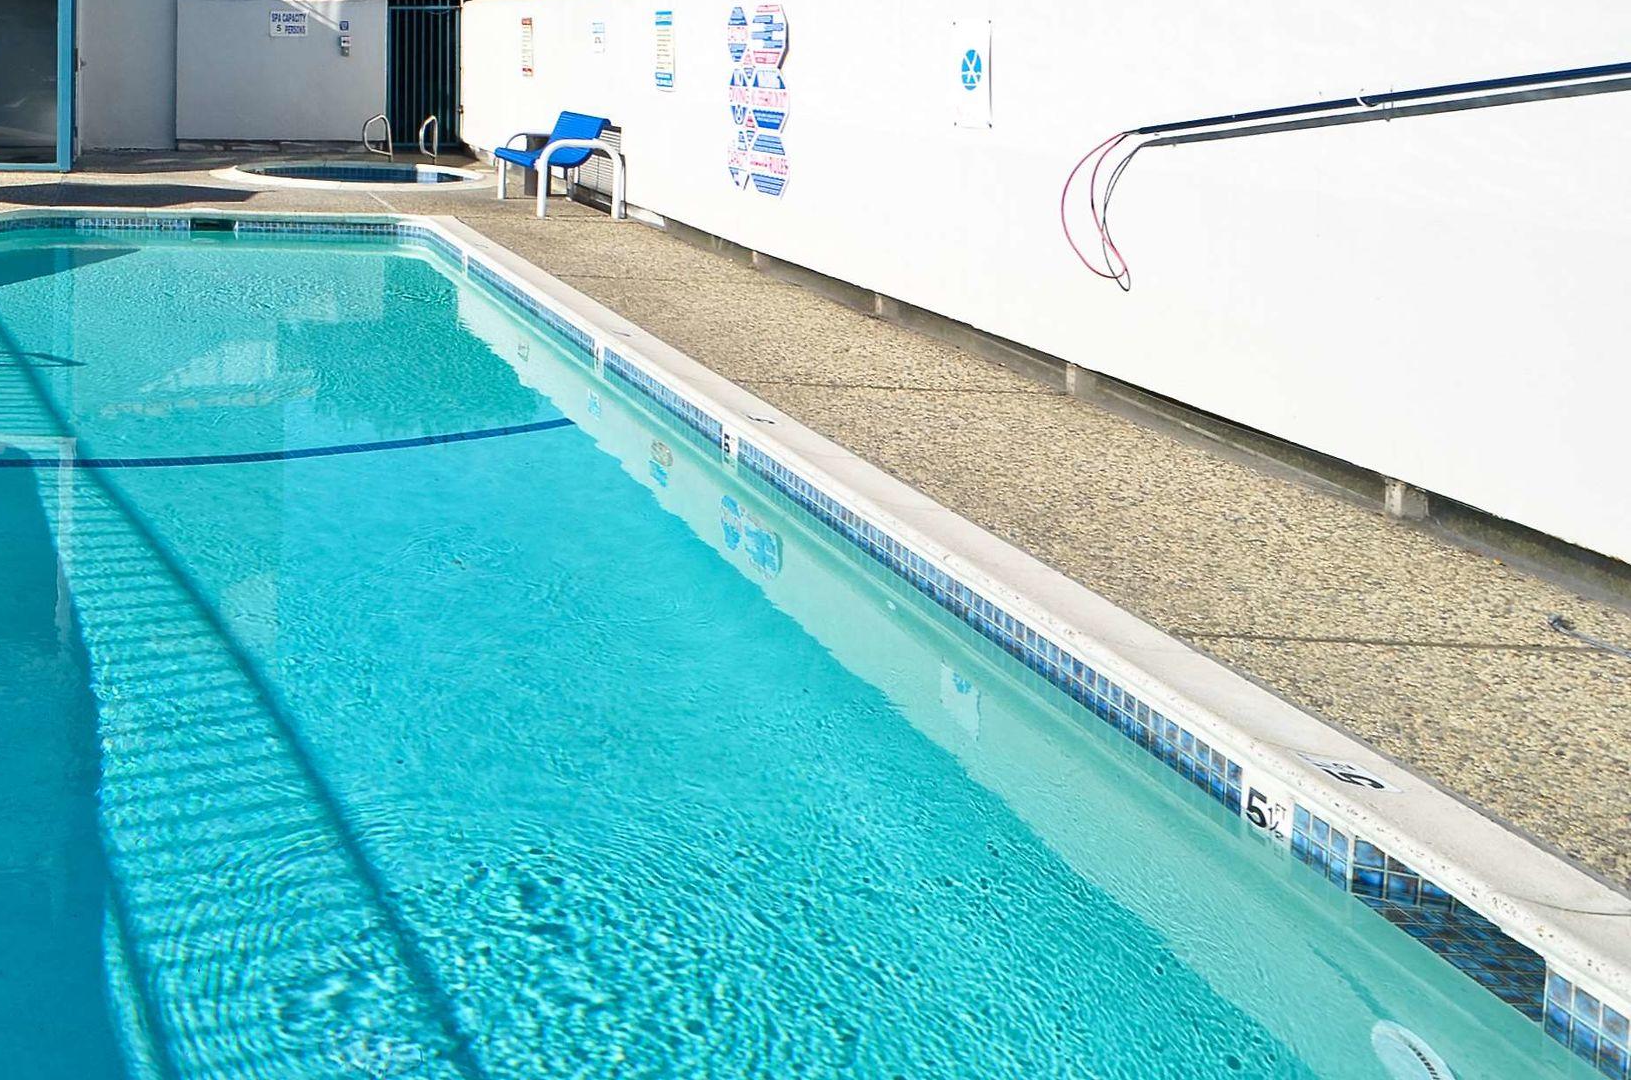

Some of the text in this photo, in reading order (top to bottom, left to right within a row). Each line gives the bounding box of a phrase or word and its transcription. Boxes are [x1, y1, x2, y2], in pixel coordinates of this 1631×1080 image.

[271, 13, 306, 22] SPA CAPACITY
[285, 25, 306, 34] PERSONS
[1246, 786, 1267, 828] 5
